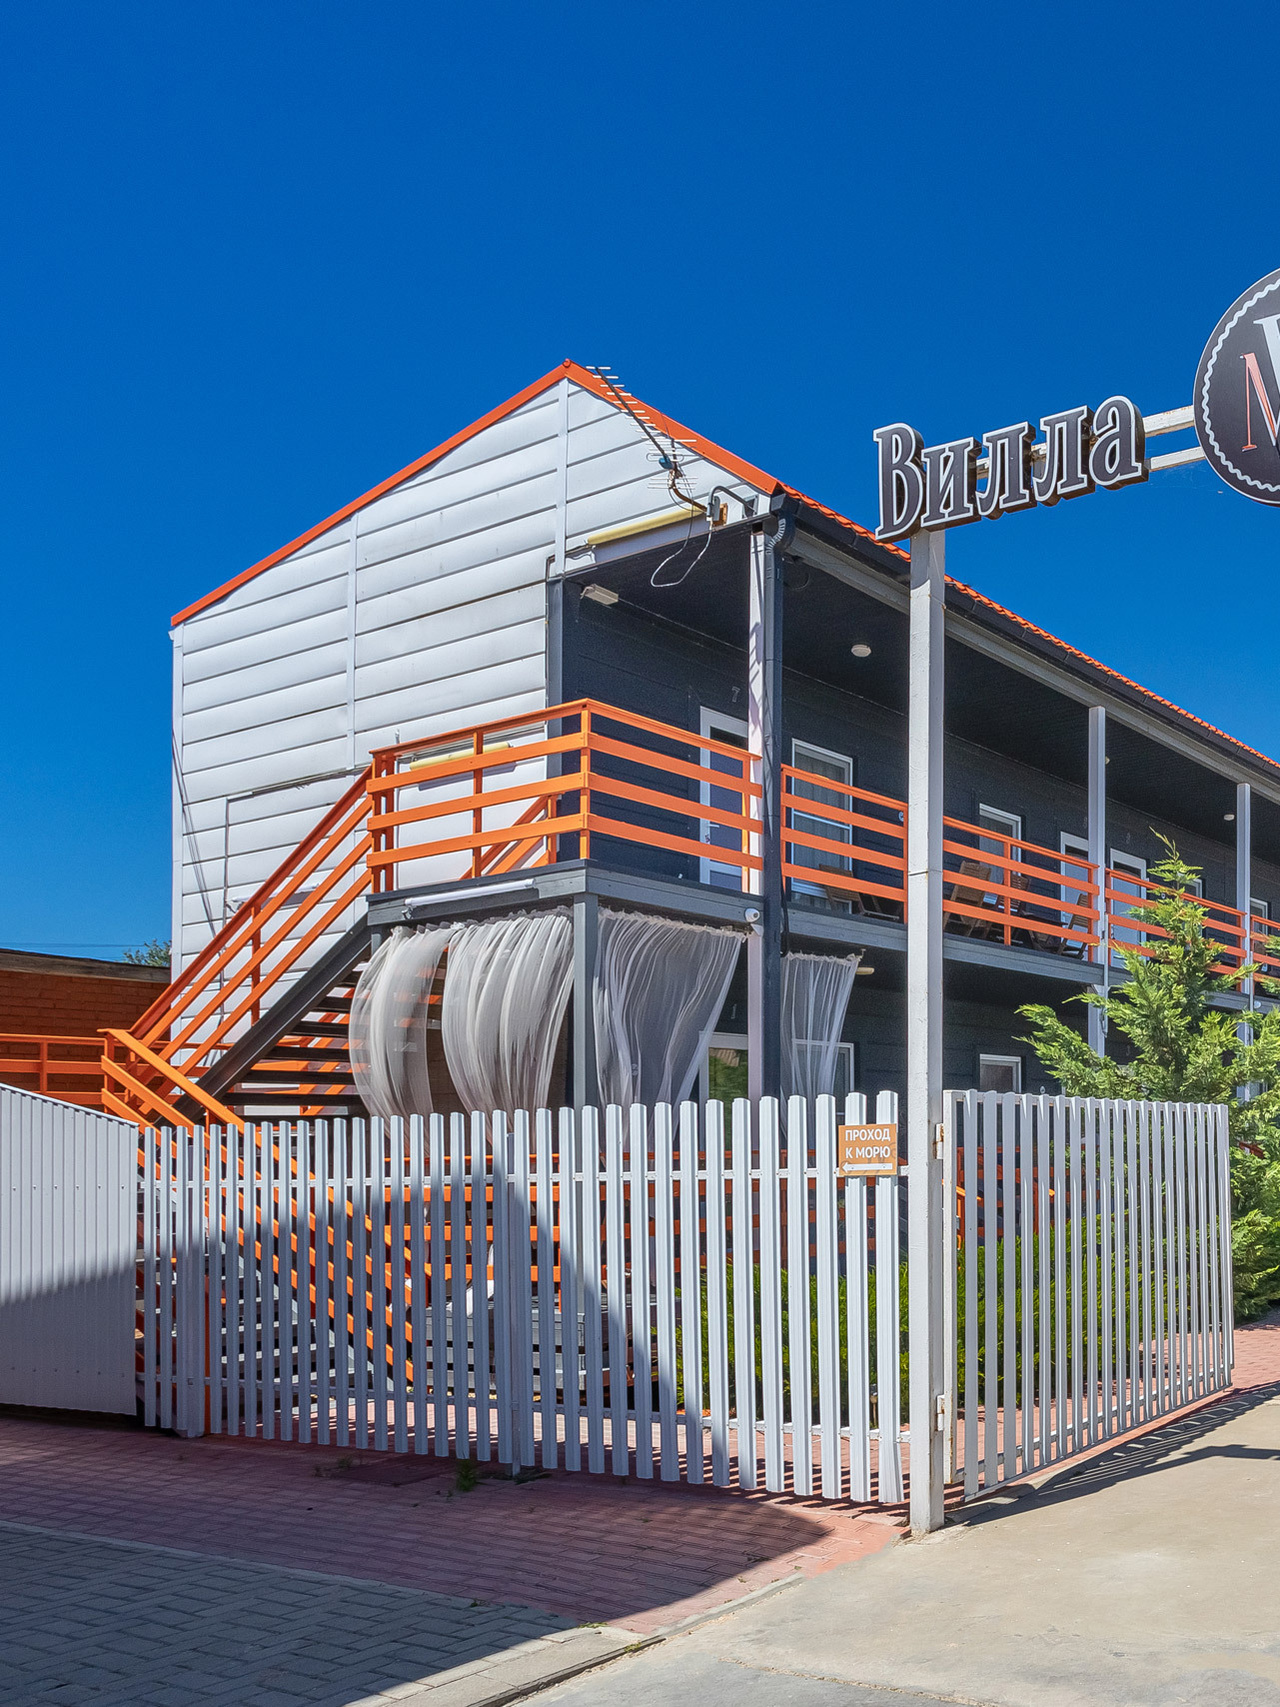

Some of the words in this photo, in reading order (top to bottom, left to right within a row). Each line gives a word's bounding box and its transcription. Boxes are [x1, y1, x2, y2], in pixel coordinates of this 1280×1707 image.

[873, 395, 1148, 541] Вилла
[845, 1128, 891, 1142] ПРОХОД
[845, 1147, 853, 1159] К
[855, 1146, 891, 1159] МОРЮ
